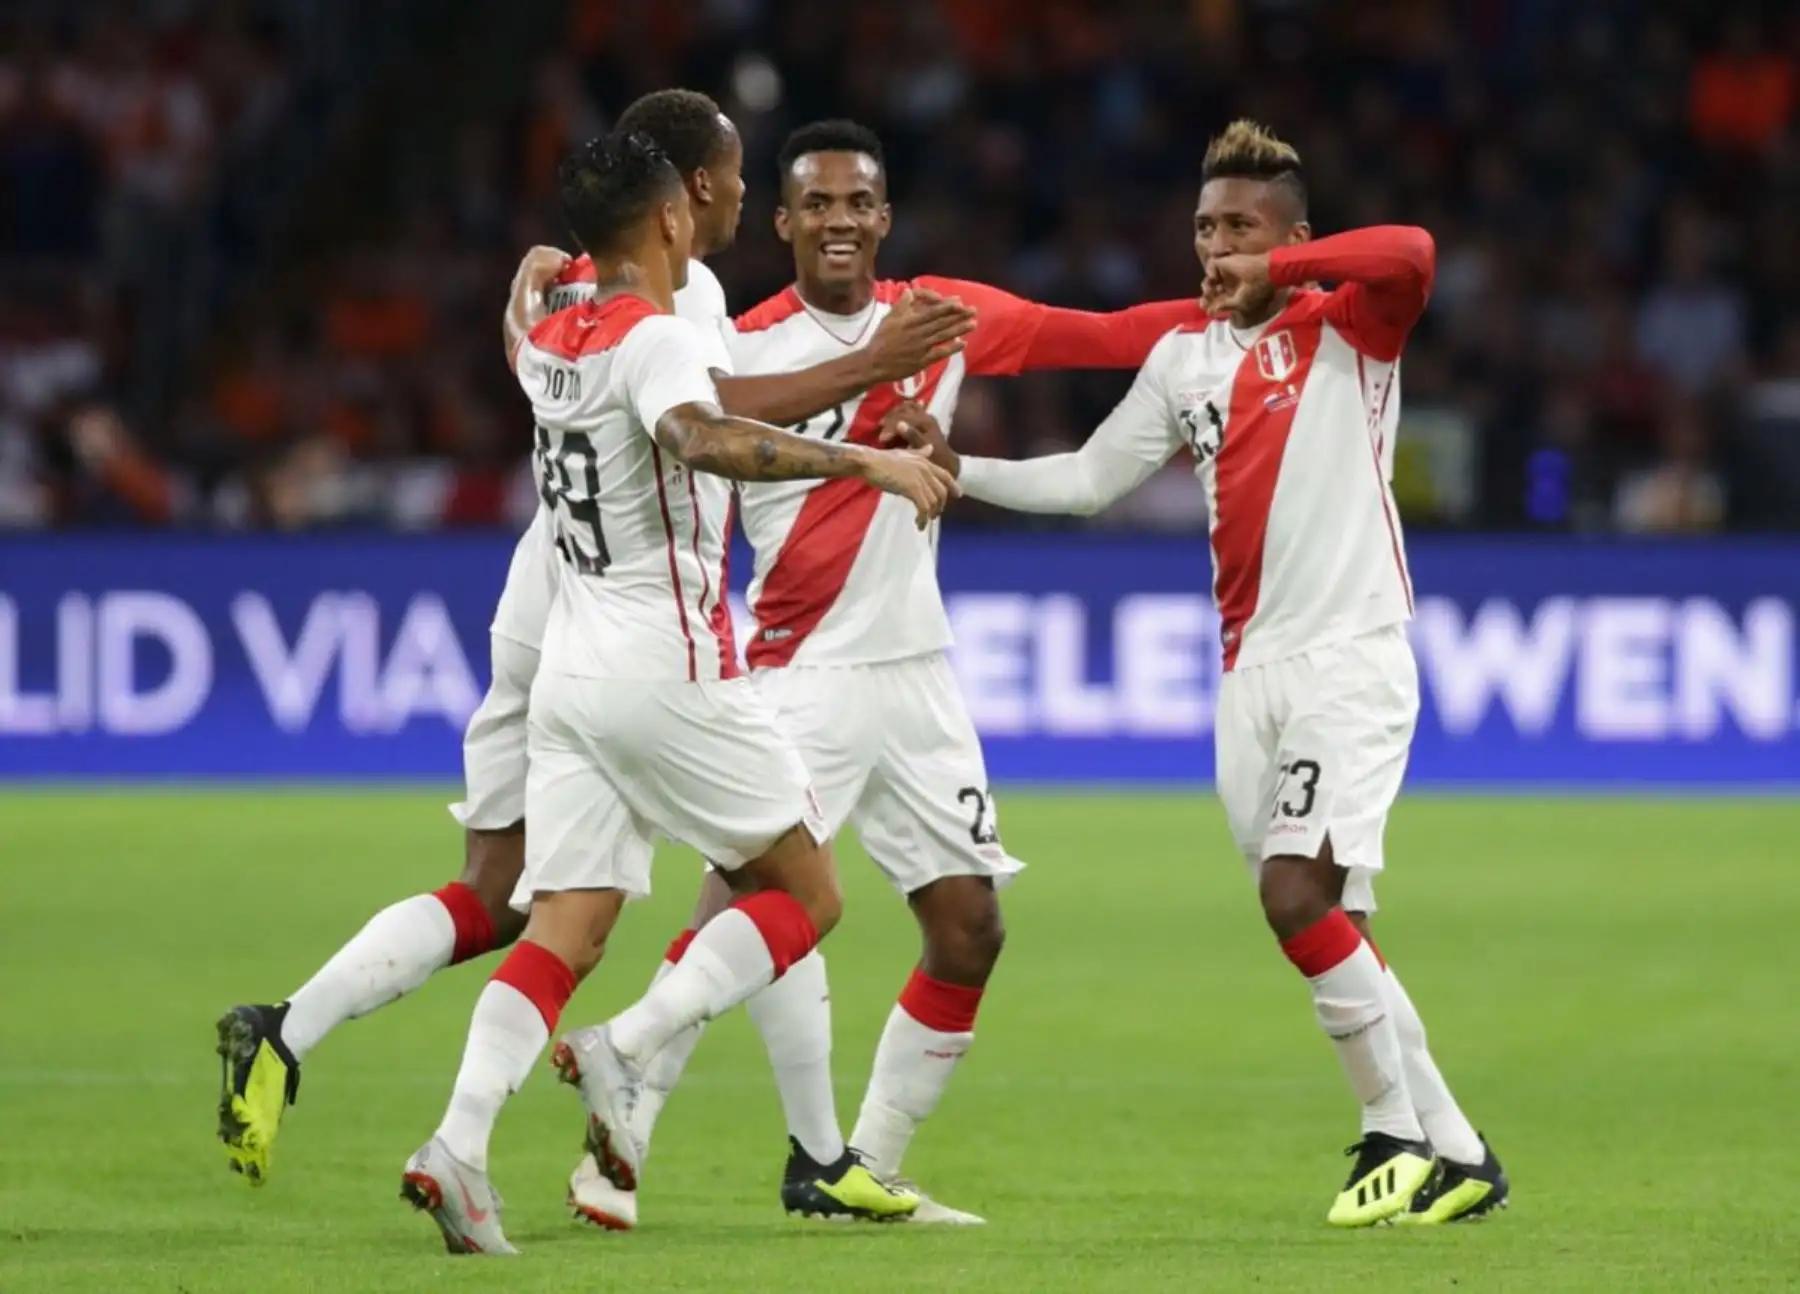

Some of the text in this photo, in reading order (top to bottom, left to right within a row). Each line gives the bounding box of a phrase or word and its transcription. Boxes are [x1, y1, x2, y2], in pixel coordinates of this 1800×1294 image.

[0, 589, 214, 736] LID
[231, 589, 485, 736] VIA
[957, 786, 999, 845] 2
